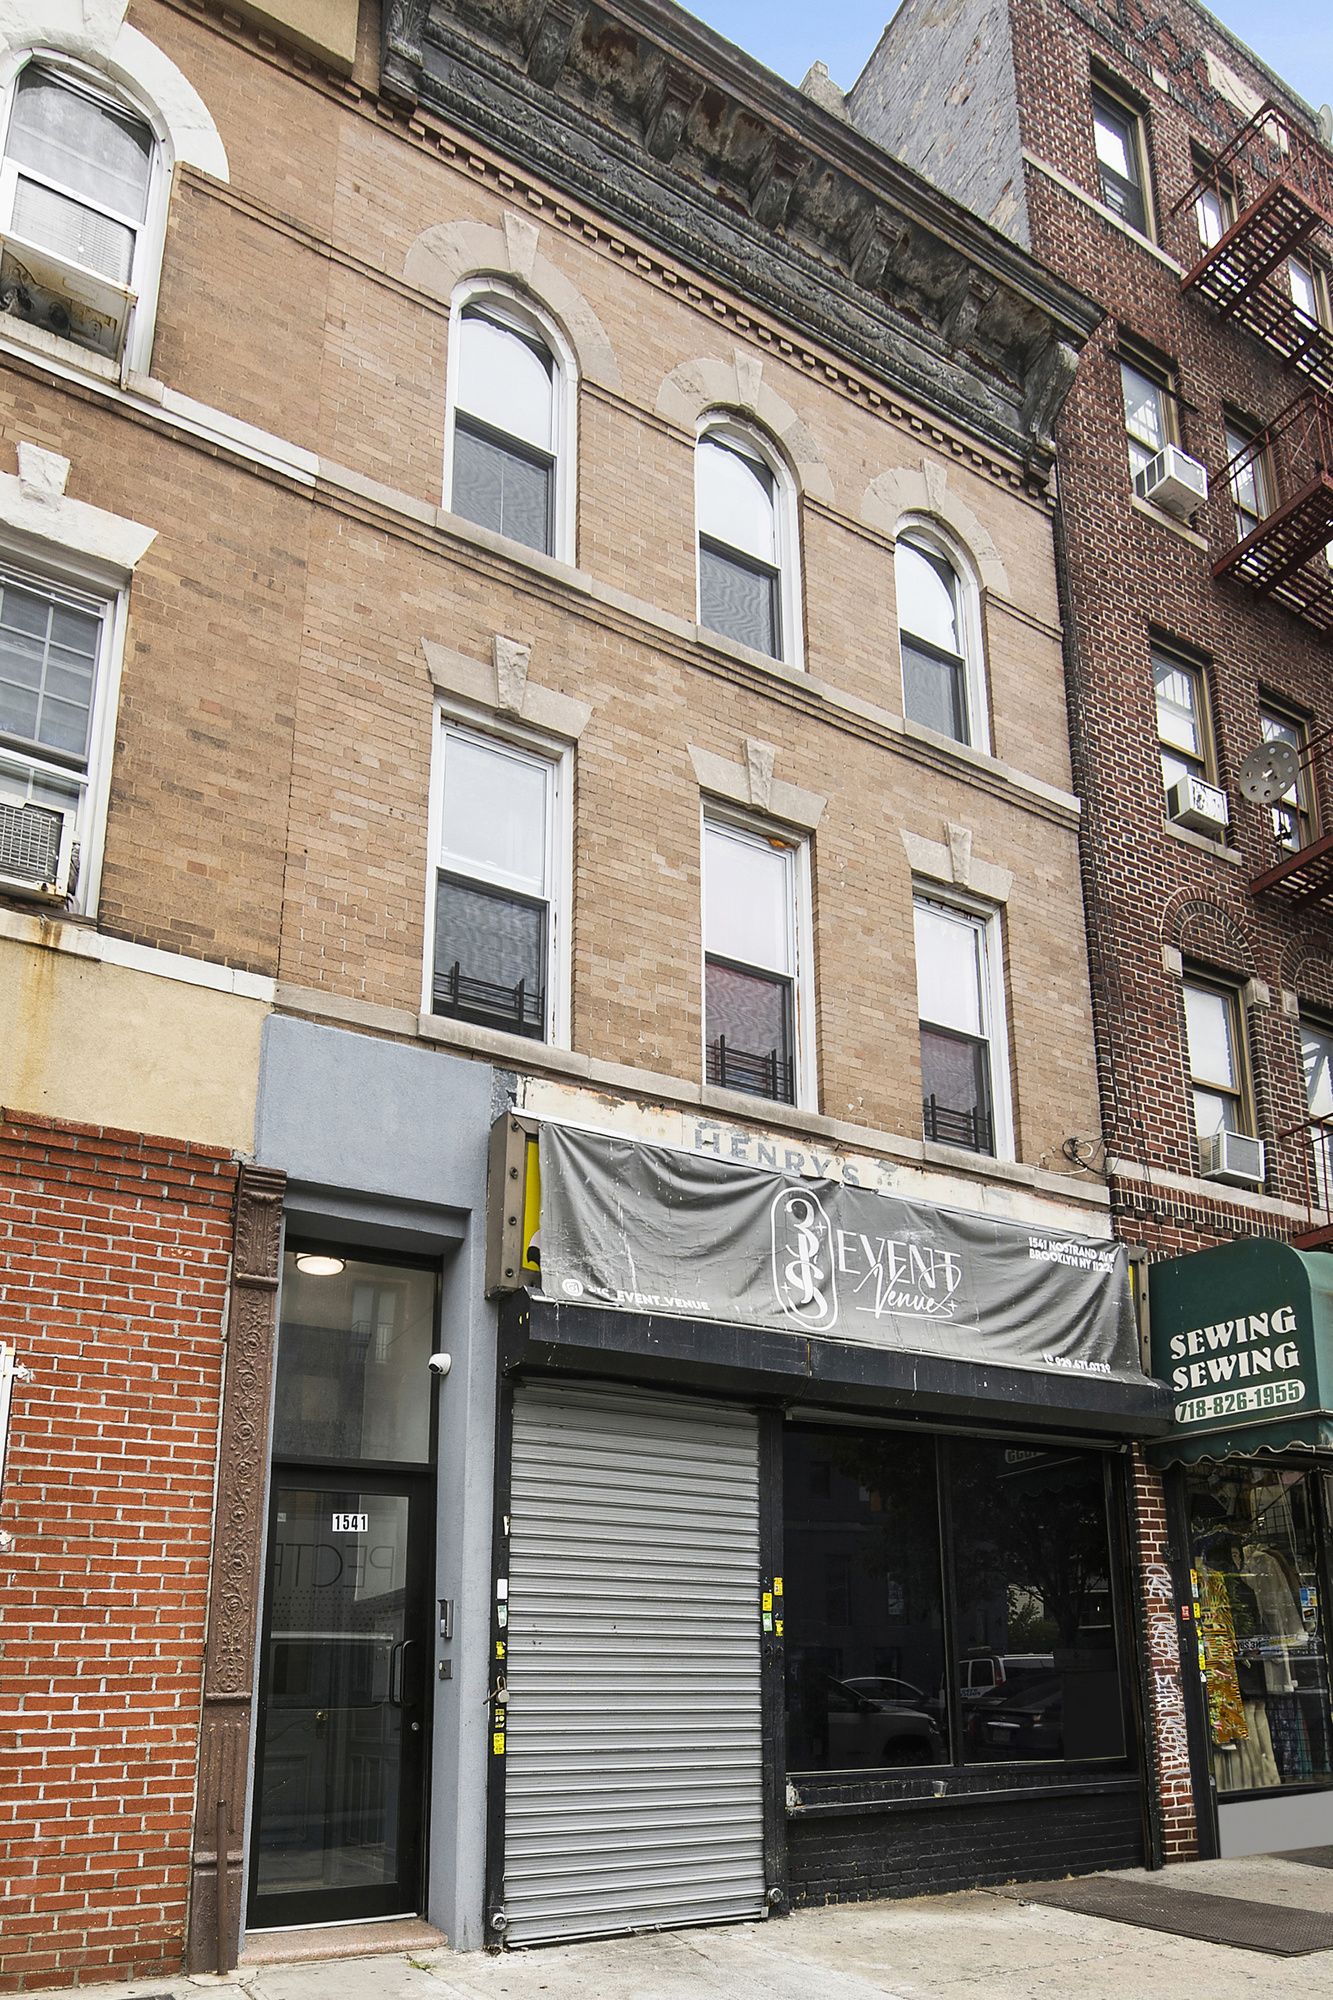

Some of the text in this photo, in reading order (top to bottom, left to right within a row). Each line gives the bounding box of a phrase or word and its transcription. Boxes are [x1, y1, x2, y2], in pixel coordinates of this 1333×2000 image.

[836, 1229, 962, 1292] EVENT
[1028, 1236, 1115, 1263] 1541 NOSTRAND AVE
[1029, 1248, 1079, 1268] BROOKLYN
[1079, 1257, 1092, 1270] NY
[852, 1262, 953, 1319] Venue
[1170, 1306, 1298, 1360] SEWING
[1172, 1341, 1300, 1392] SEWING
[1178, 1380, 1301, 1422] 718-826-1955
[335, 1515, 366, 1531] 1541
